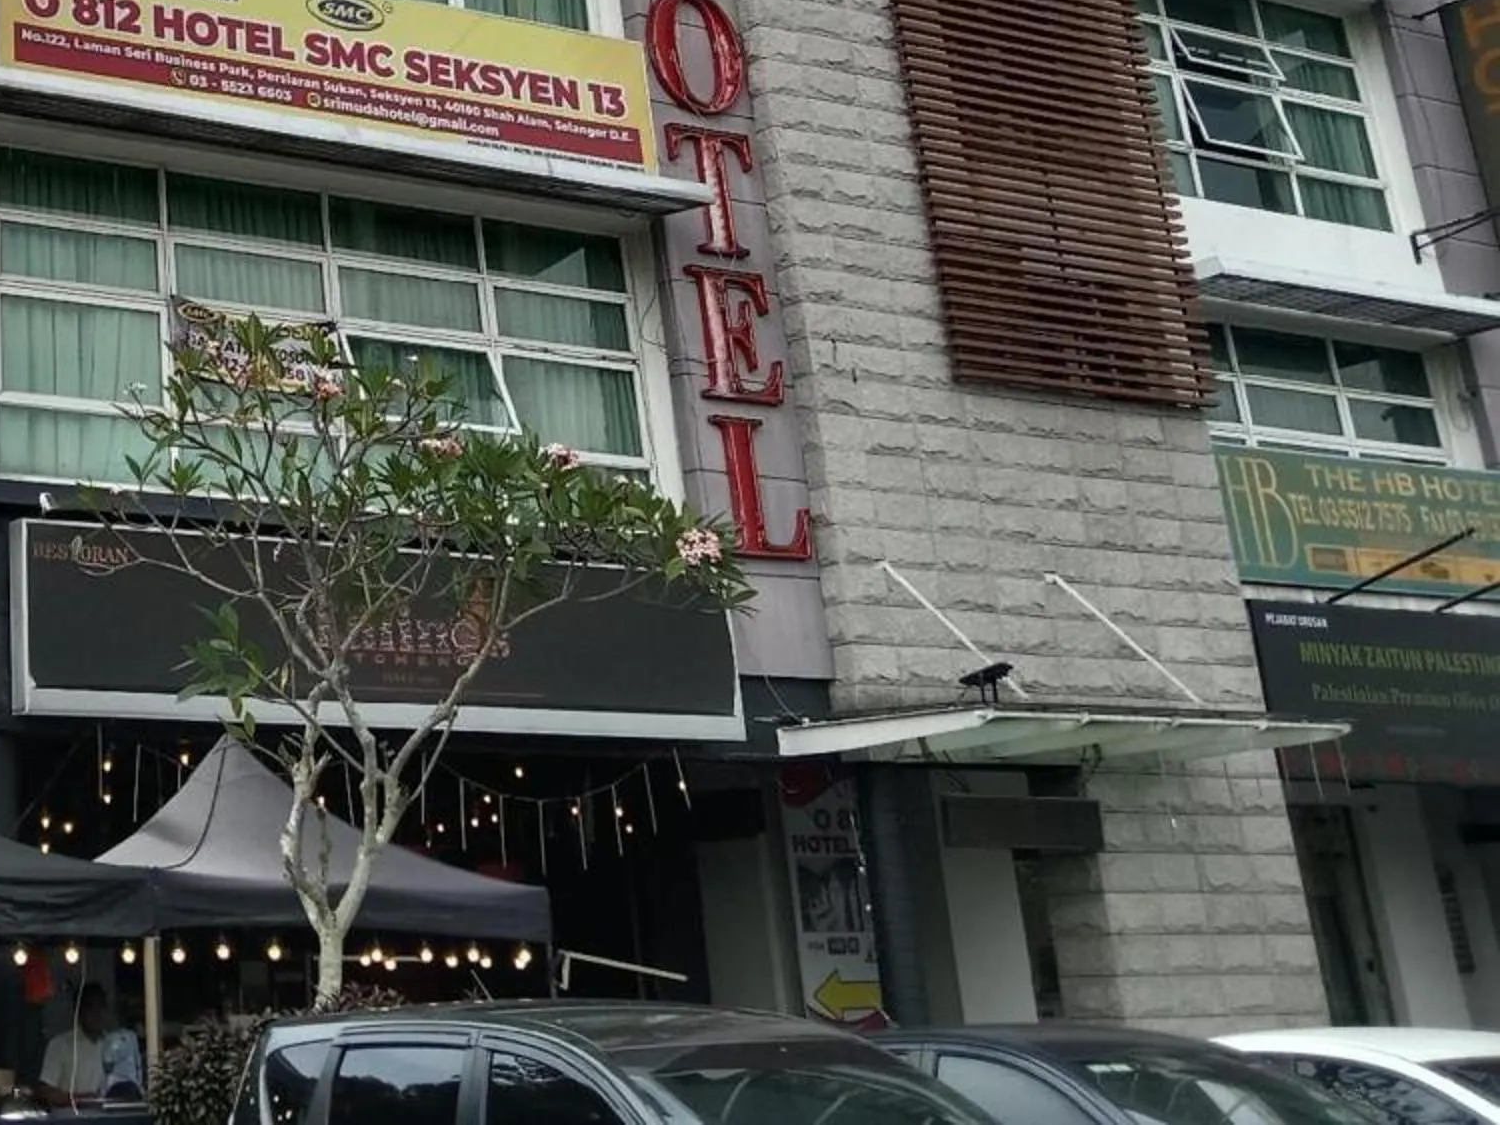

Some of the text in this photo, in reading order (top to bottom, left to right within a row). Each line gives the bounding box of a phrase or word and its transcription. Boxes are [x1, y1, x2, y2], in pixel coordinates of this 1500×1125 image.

[322, 0, 373, 22] SMC
[153, 5, 295, 61] HOTEL
[304, 32, 395, 78] SMC
[403, 49, 581, 111] SEKSYEN
[588, 83, 626, 118] 13
[73, 37, 121, 56] Laman
[124, 46, 151, 61] Seri
[155, 52, 216, 73] Business
[219, 62, 255, 81] Park,
[257, 69, 321, 90] Persiaran
[323, 81, 368, 100] Sukan,
[370, 88, 423, 108] Seksyen
[483, 107, 515, 123] Shah
[555, 120, 607, 139] Selangor
[1304, 463, 1367, 493] THE
[1372, 469, 1417, 497] HB
[32, 540, 130, 565] RESORAN
[1299, 641, 1362, 667] MINYAK
[792, 834, 858, 854] HOTEL
